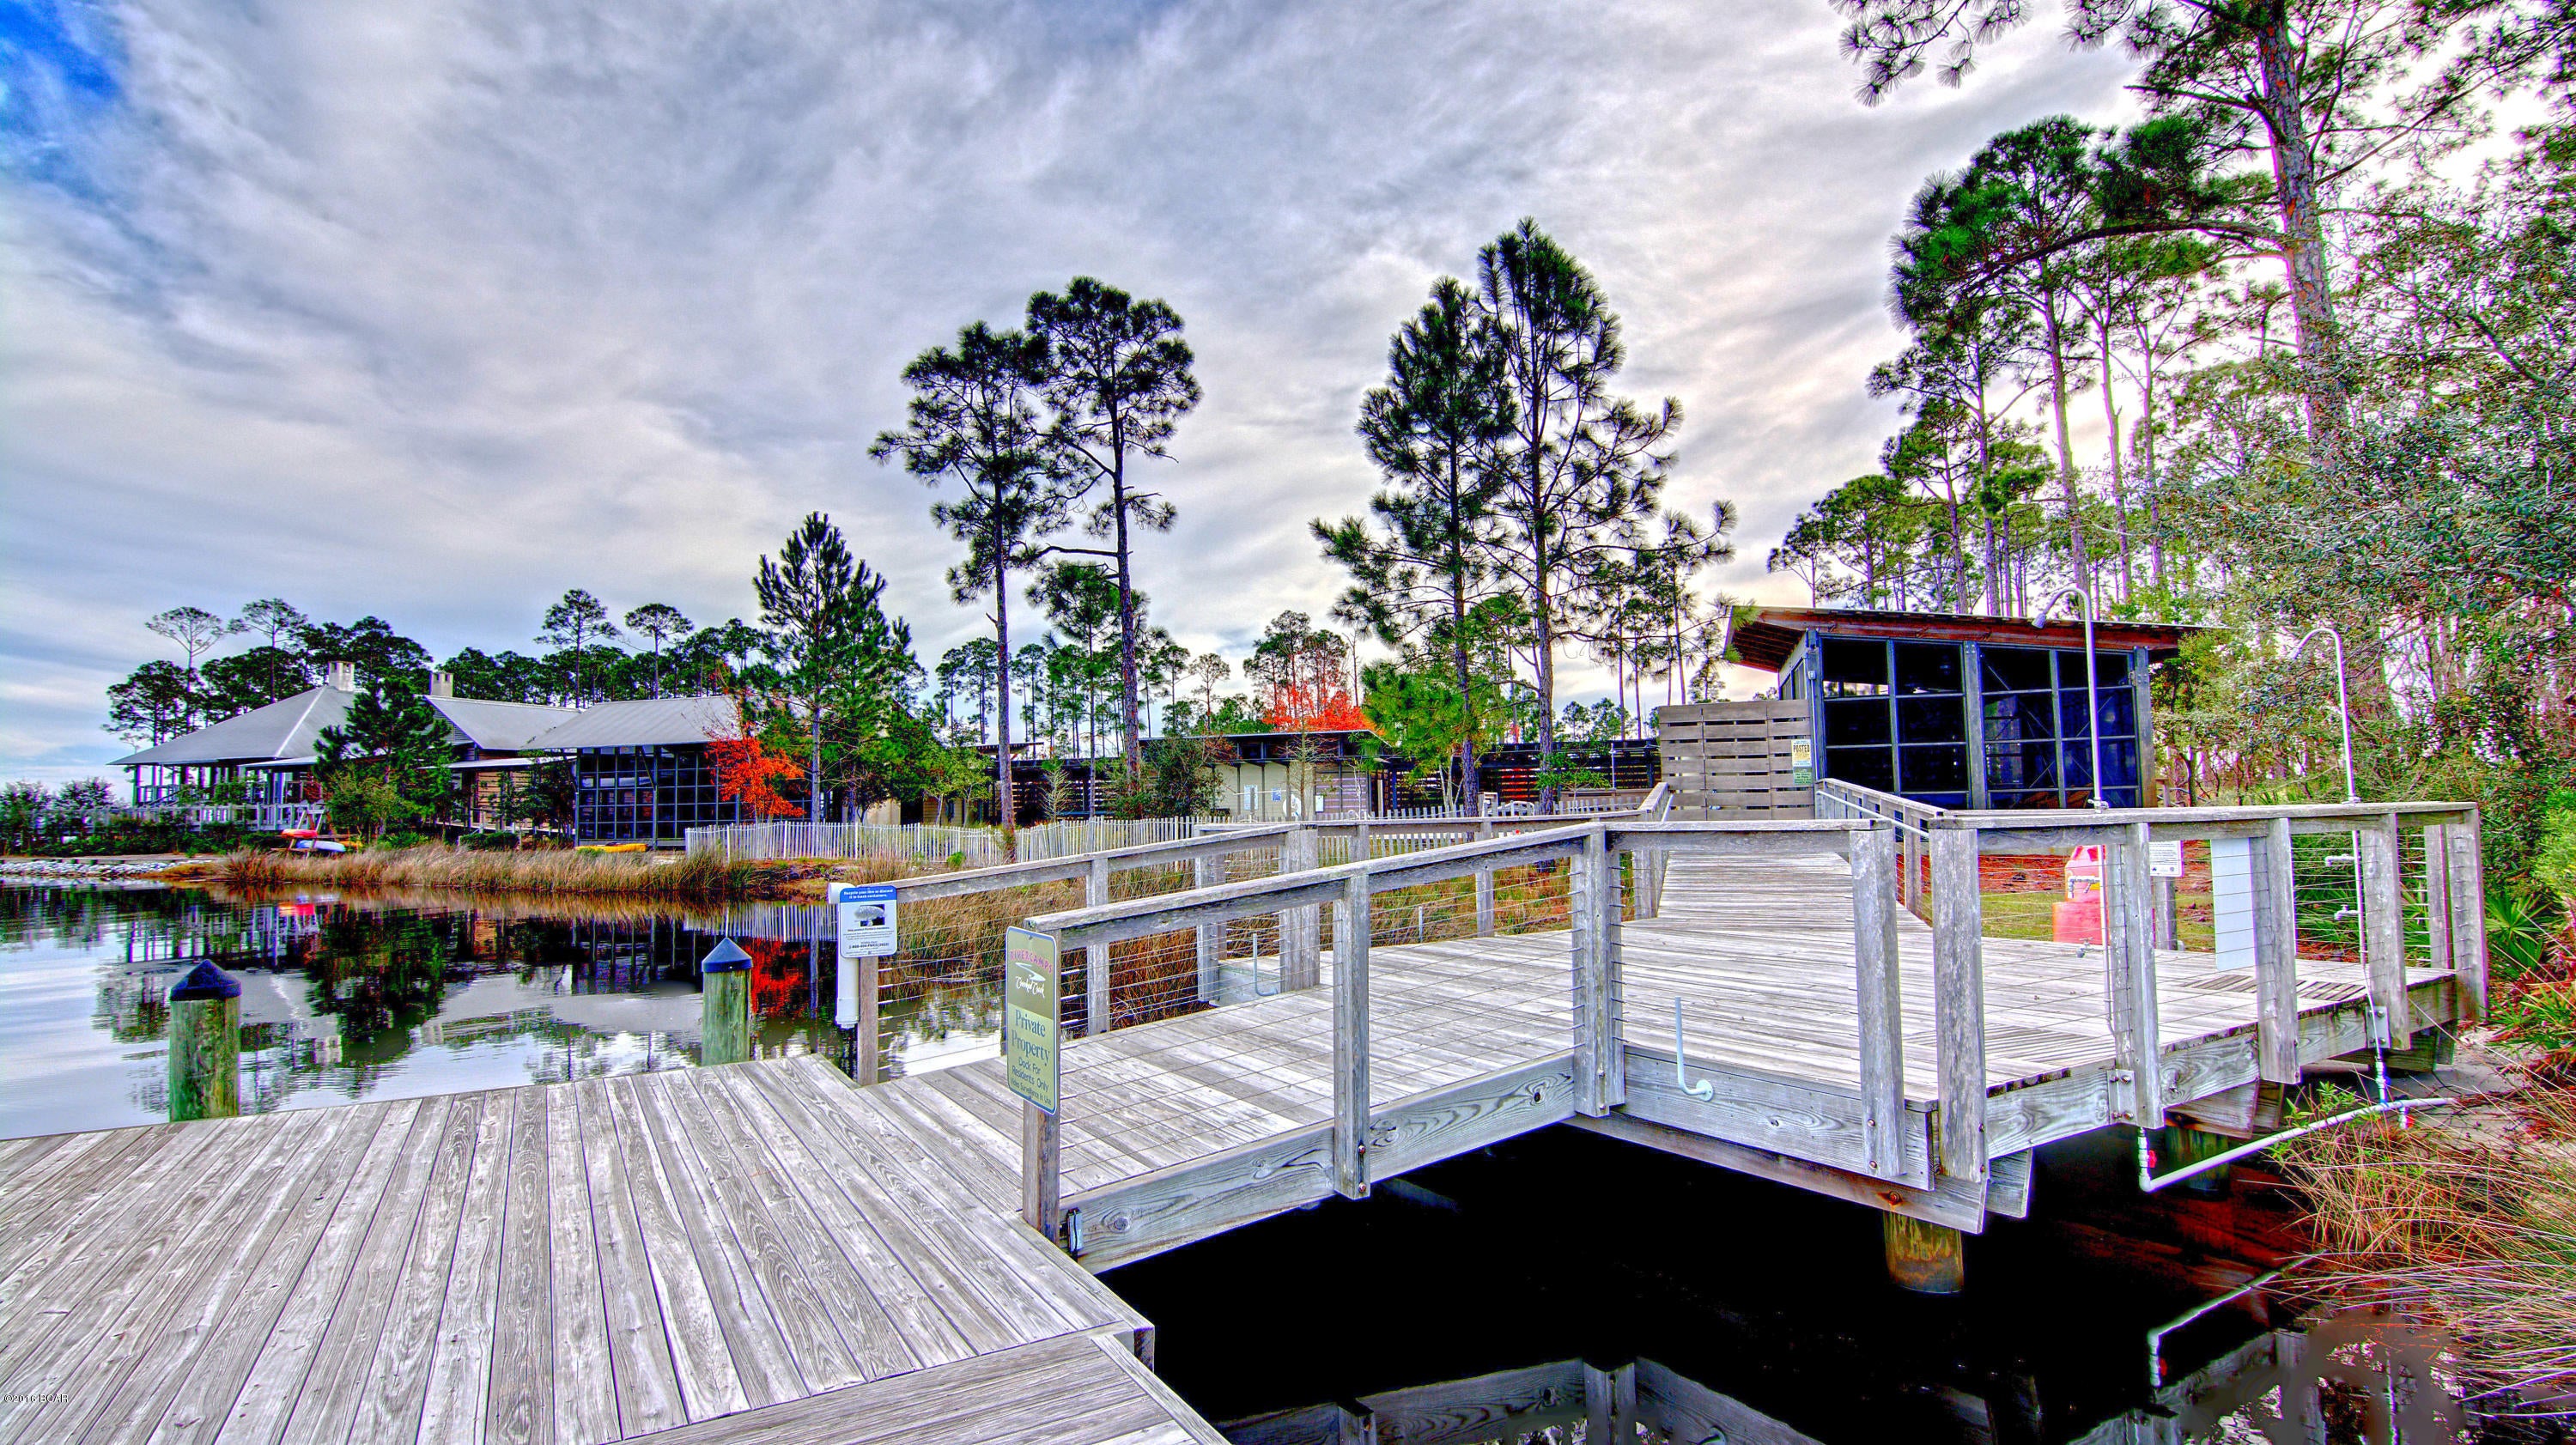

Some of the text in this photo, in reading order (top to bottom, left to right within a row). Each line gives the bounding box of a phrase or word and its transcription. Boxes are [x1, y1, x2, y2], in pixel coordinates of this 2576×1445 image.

[1009, 949, 1053, 974] RIVERCAMPS
[1015, 1009, 1046, 1037] Private
[1012, 1029, 1050, 1066] Property
[1018, 1056, 1041, 1074] Dock For
[1012, 1066, 1049, 1093] Residents Only
